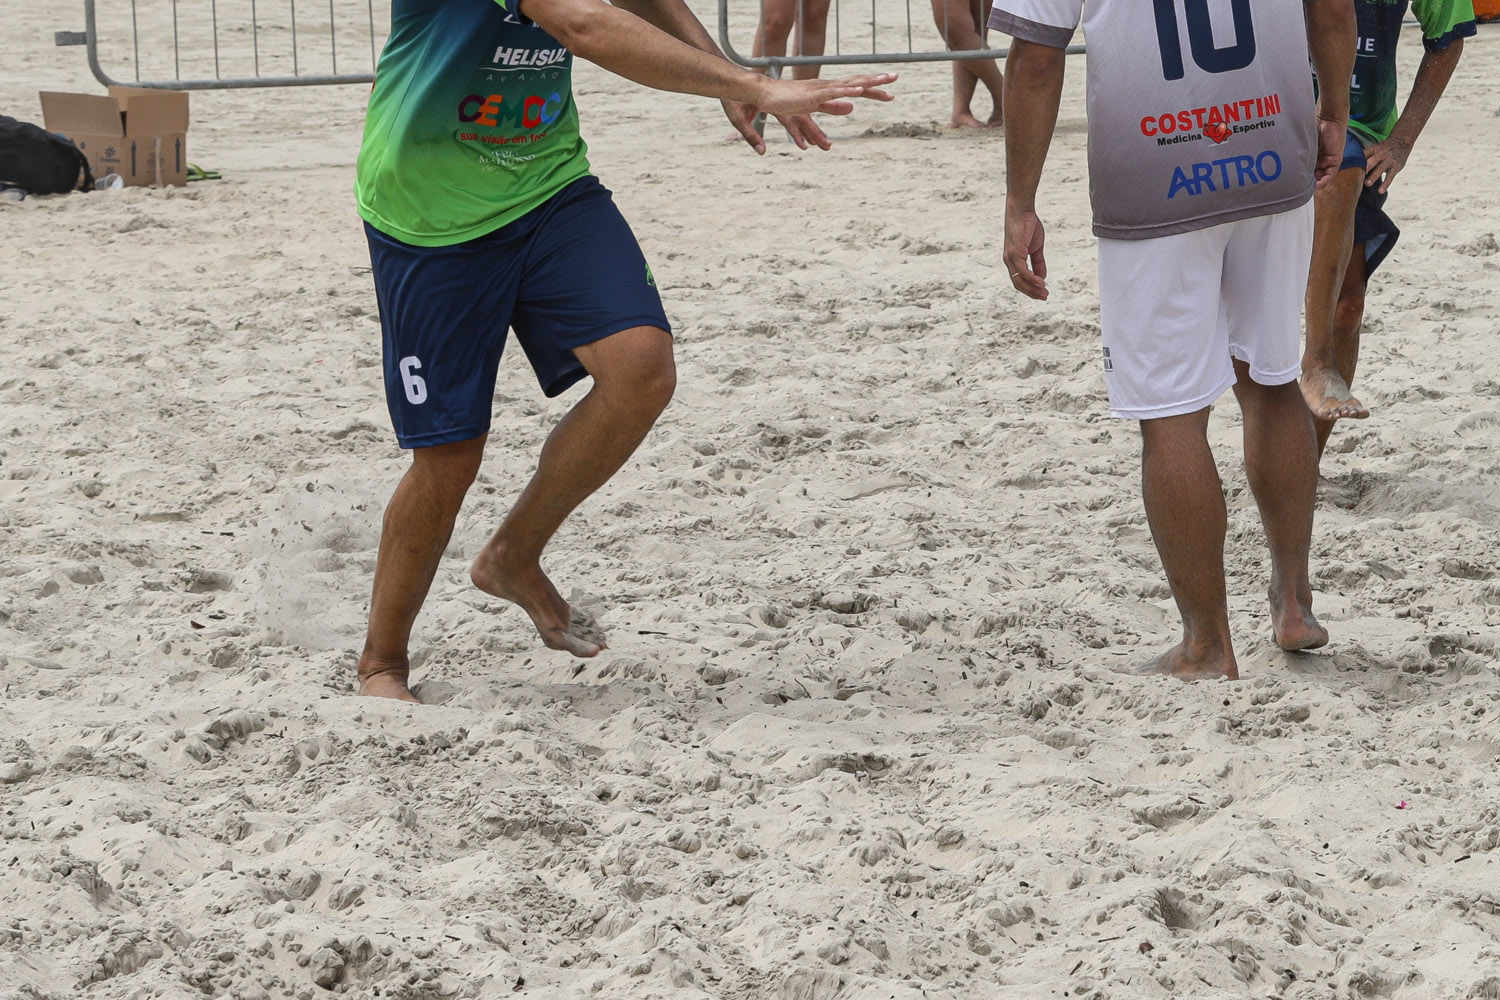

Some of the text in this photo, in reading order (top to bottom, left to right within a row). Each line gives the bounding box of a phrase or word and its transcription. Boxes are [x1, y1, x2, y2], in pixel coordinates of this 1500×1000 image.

[493, 46, 568, 66] HELISUL
[458, 92, 561, 129] CEMOC
[1140, 93, 1282, 137] COSTANTINI
[1157, 132, 1202, 147] Medicina
[1167, 150, 1282, 200] ARTRO
[399, 355, 428, 405] 6
